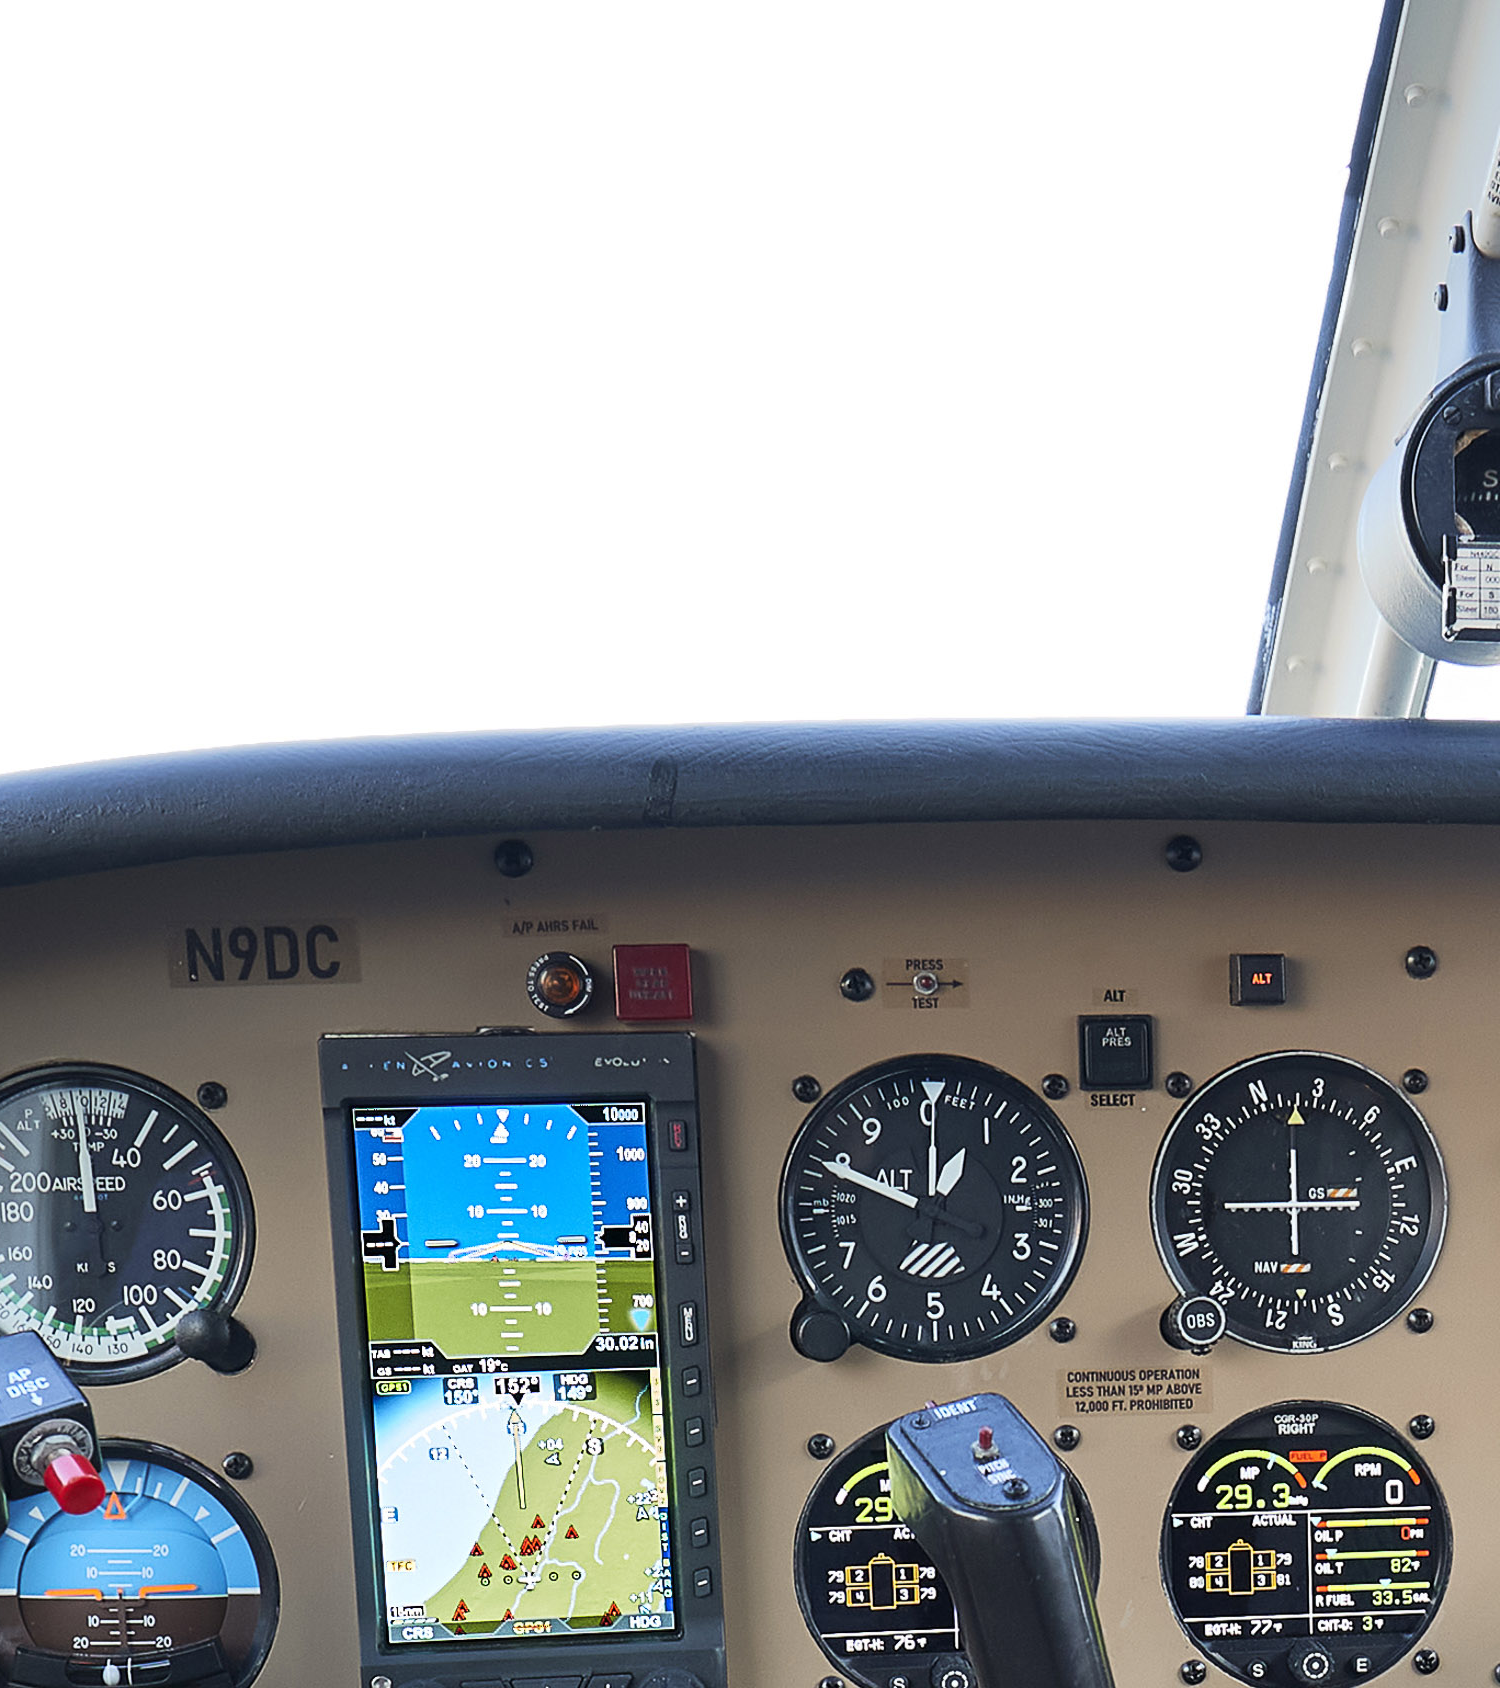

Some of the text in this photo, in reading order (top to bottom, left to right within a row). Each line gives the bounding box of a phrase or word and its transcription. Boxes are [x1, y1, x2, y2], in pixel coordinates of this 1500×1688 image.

[1483, 470, 1499, 487] S
[512, 919, 598, 935] A/P AHRS FAIL
[186, 925, 341, 981] N9DC
[905, 959, 943, 972] PRESS
[1252, 972, 1272, 985] ALT
[912, 998, 939, 1010] TEST
[1104, 990, 1126, 1002] ALT
[1090, 1094, 1136, 1107] SELECT
[111, 1147, 141, 1169] 40
[10, 1172, 49, 1194] 200
[152, 1190, 182, 1211] 60
[122, 1284, 158, 1306] 100
[1185, 1312, 1215, 1329] OBS
[8, 1368, 32, 1384] AP
[1067, 1369, 1201, 1383] CONTINUOUS OPERATION
[6, 1376, 50, 1399] DISC
[496, 1376, 539, 1395] 152°
[1066, 1385, 1094, 1397] LESS
[1097, 1385, 1126, 1396] THAN
[1147, 1384, 1164, 1395] MP
[1167, 1383, 1202, 1395] ABOVE
[932, 1398, 977, 1421] IDENT
[1075, 1398, 1193, 1412] 12,000 FT. PROHIBITED
[1278, 1423, 1315, 1435] RIGHT
[402, 1626, 434, 1640] CRS
